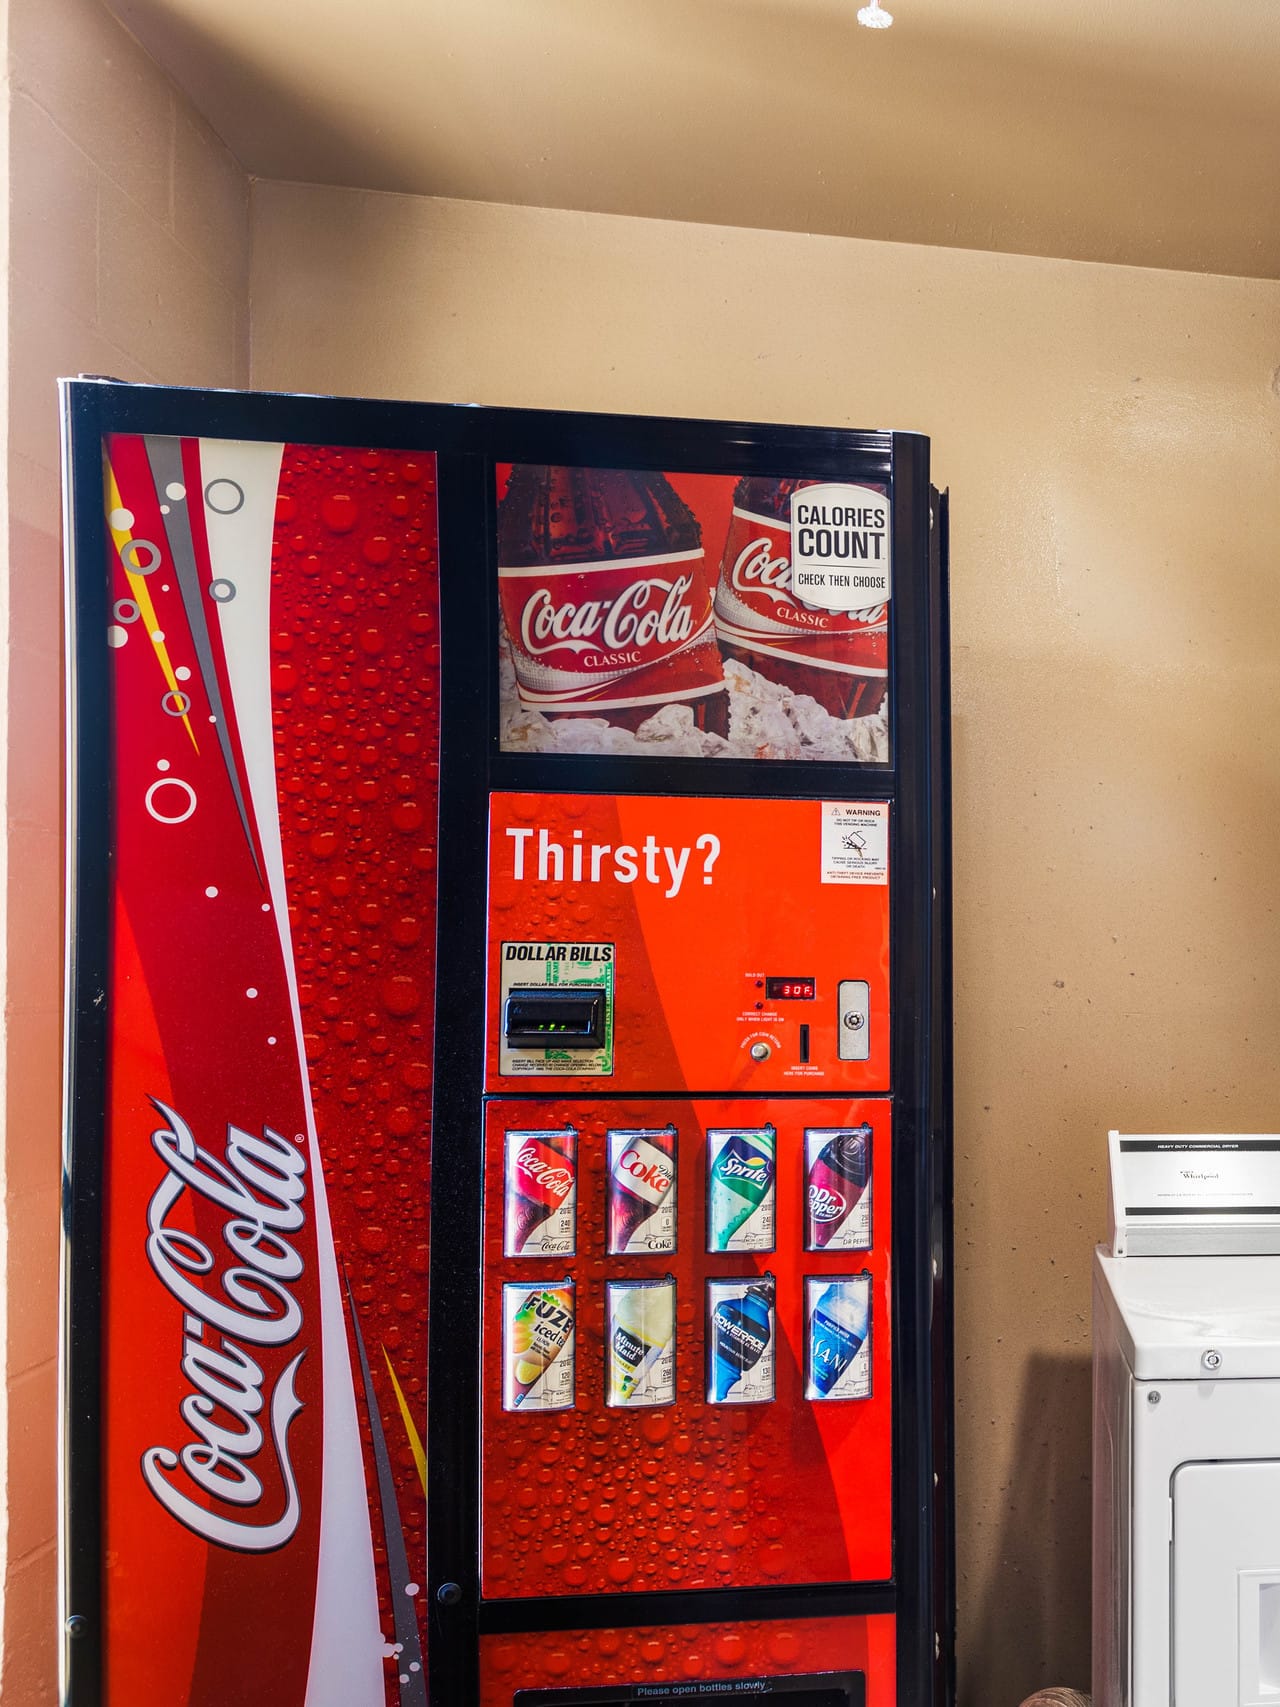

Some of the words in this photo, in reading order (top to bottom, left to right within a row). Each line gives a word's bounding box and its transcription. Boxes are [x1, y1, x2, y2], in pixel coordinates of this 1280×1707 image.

[798, 505, 885, 528] CALORIES
[799, 528, 885, 560] COUNT
[798, 573, 825, 586] CHECK
[829, 575, 850, 587] THEN
[853, 576, 885, 588] CHOOSE
[521, 572, 694, 654] Coca-Cola
[776, 606, 829, 628] CLASSIC
[583, 651, 641, 668] CLASSIC
[506, 828, 721, 898] Thirsty?
[506, 946, 566, 961] DOLLAR
[570, 946, 611, 961] BILLS
[514, 1148, 574, 1196] Coca-Cola
[619, 1149, 669, 1193] Coke
[720, 1158, 768, 1181] Sprite
[648, 1240, 672, 1250] Coke
[141, 1093, 307, 1553] Coca-Cola
[526, 1297, 573, 1333] FUZE
[534, 1322, 557, 1340] iced
[615, 1341, 636, 1360] Maid
[616, 1332, 644, 1355] Minute
[638, 1687, 670, 1696] Please
[672, 1686, 696, 1695] open
[700, 1683, 732, 1692] bottles
[735, 1681, 765, 1690] slowly
